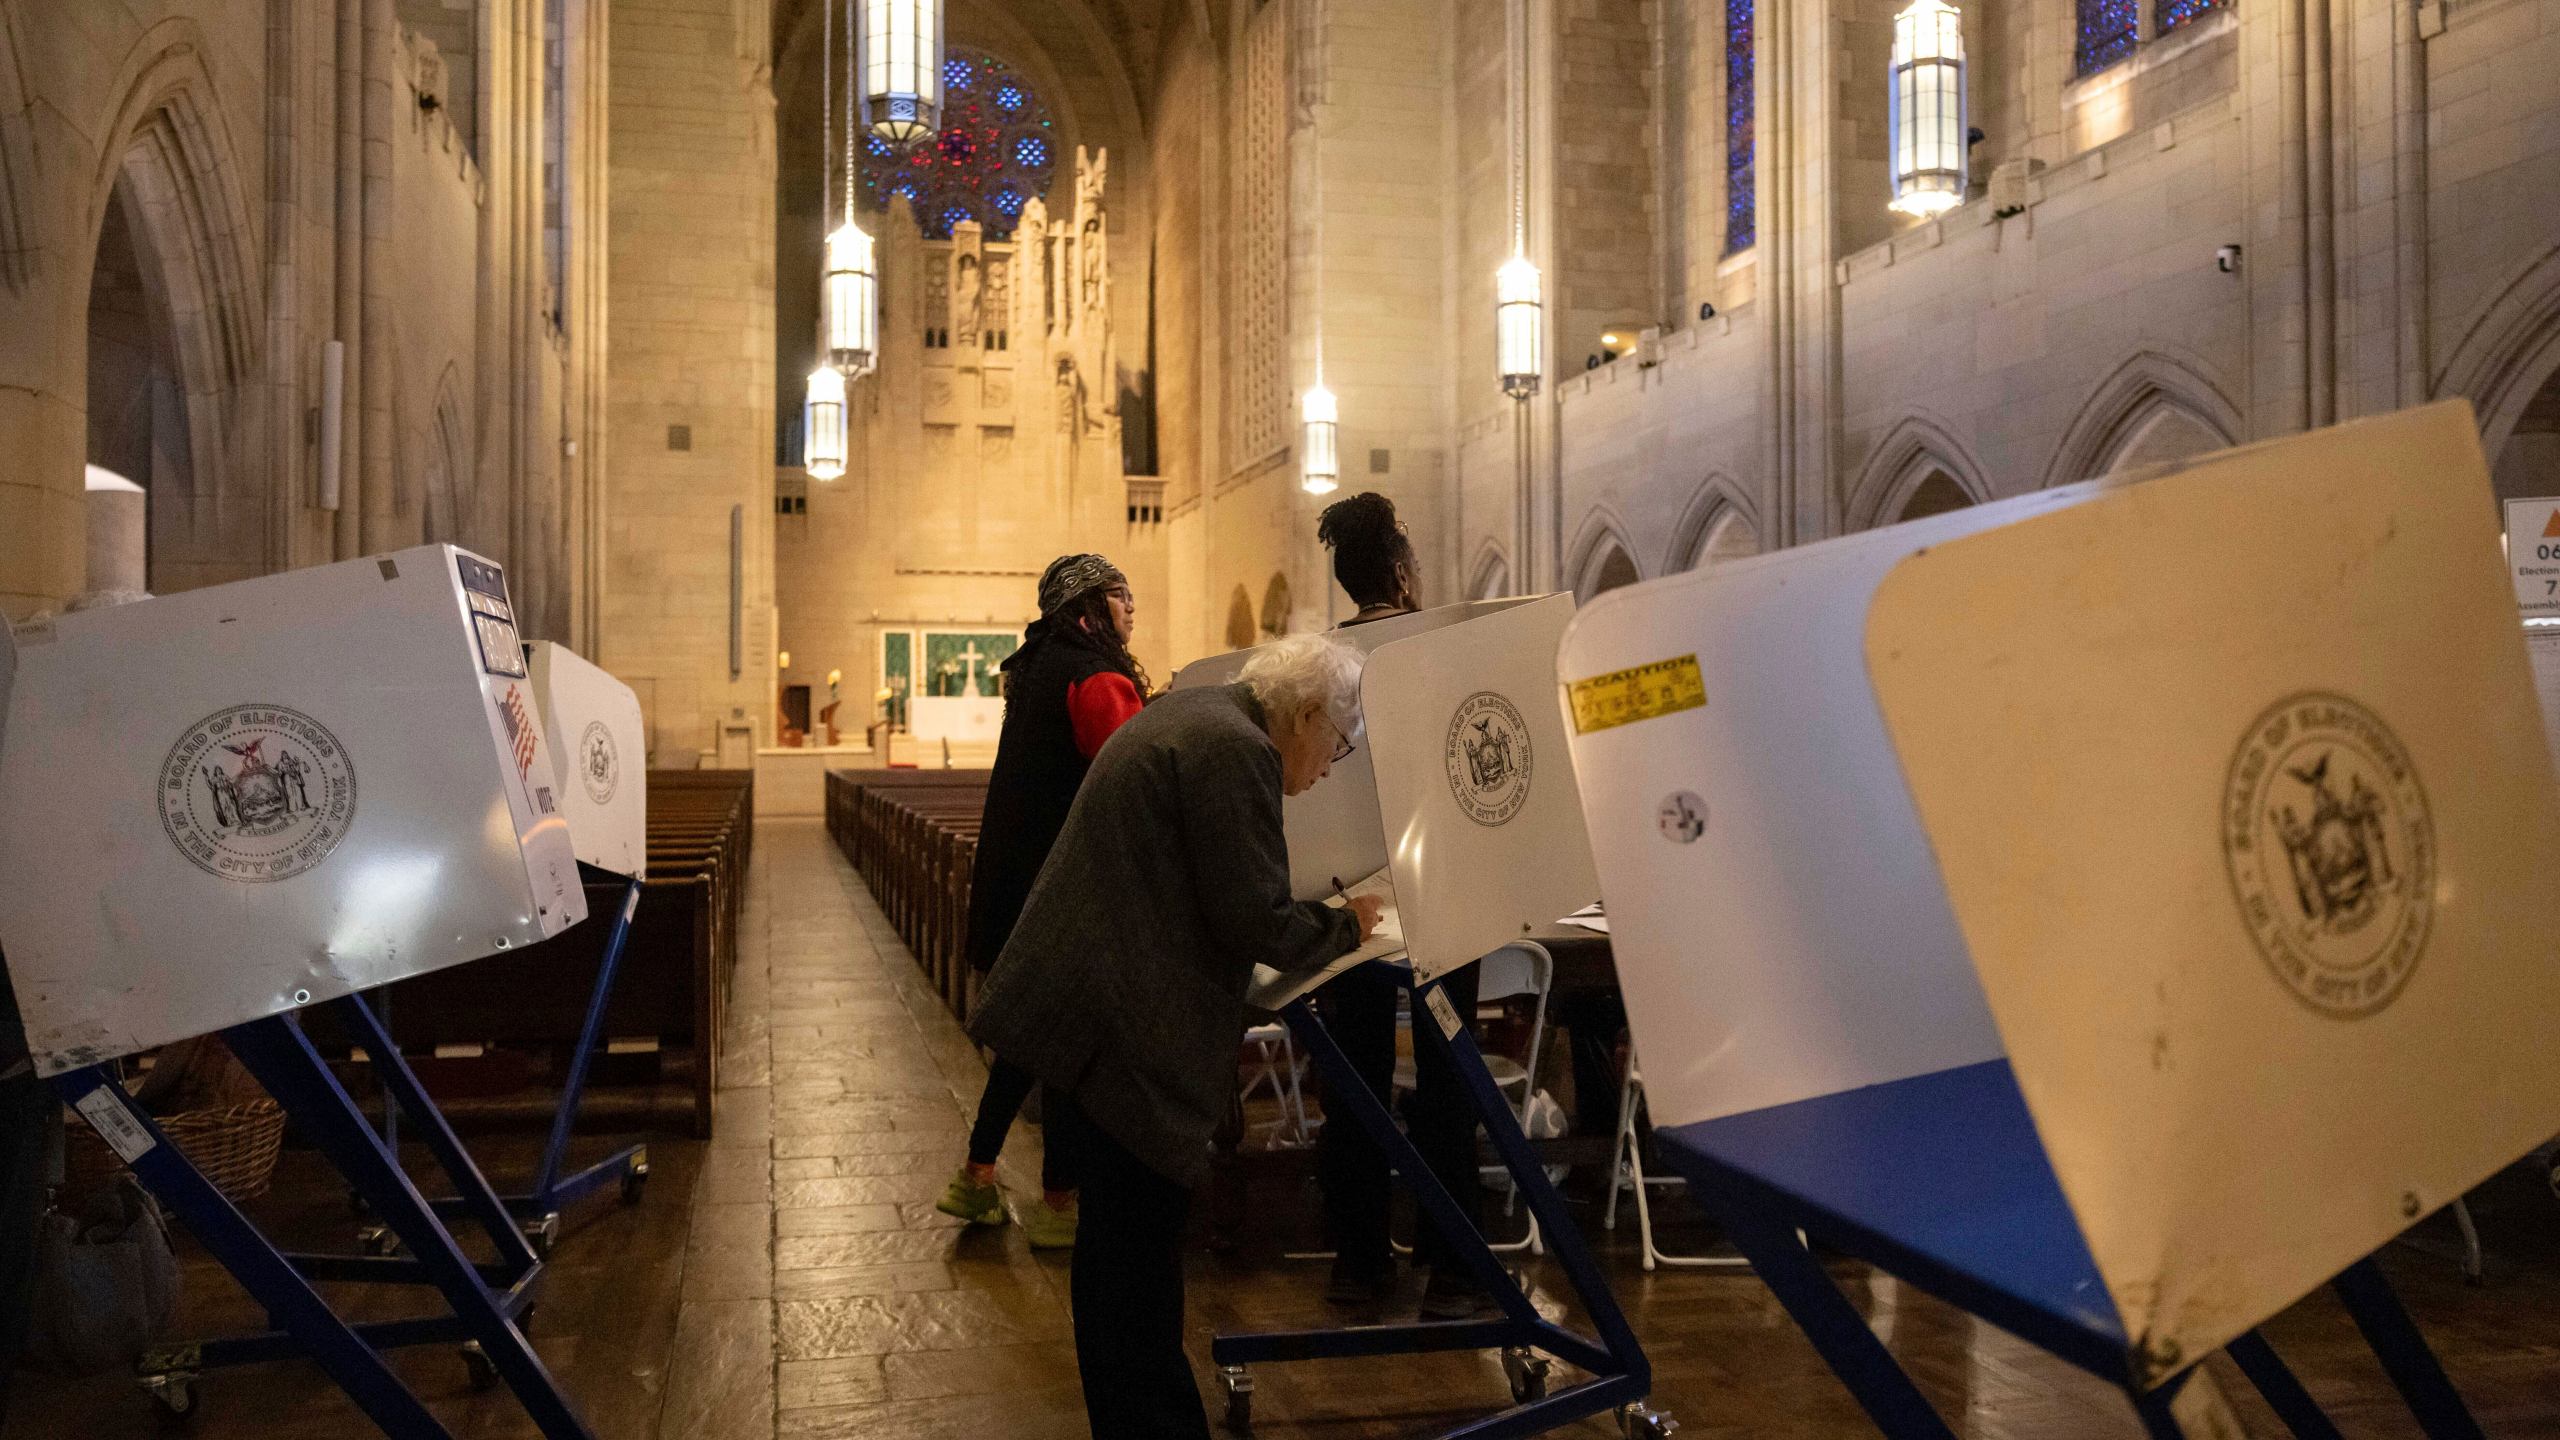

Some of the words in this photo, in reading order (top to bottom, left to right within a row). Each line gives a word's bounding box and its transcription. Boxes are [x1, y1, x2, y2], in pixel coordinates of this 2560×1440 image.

[2519, 566, 2560, 576] Election
[1593, 656, 1695, 687] CAUTION
[1449, 713, 1465, 757] BOARD
[1465, 703, 1475, 716] OF
[1477, 697, 1521, 731] ELECTIONS
[168, 733, 208, 790] BOARD
[209, 716, 233, 735] OF
[239, 712, 334, 759] ELECTIONS
[535, 787, 555, 814] VOTE
[1476, 808, 1497, 820] CITY
[1498, 805, 1509, 818] OF
[172, 813, 189, 830] IN
[184, 831, 217, 861] THE
[219, 857, 265, 874] CITY
[270, 855, 294, 872] OF
[298, 825, 333, 861] NEW
[327, 776, 346, 824] YORK
